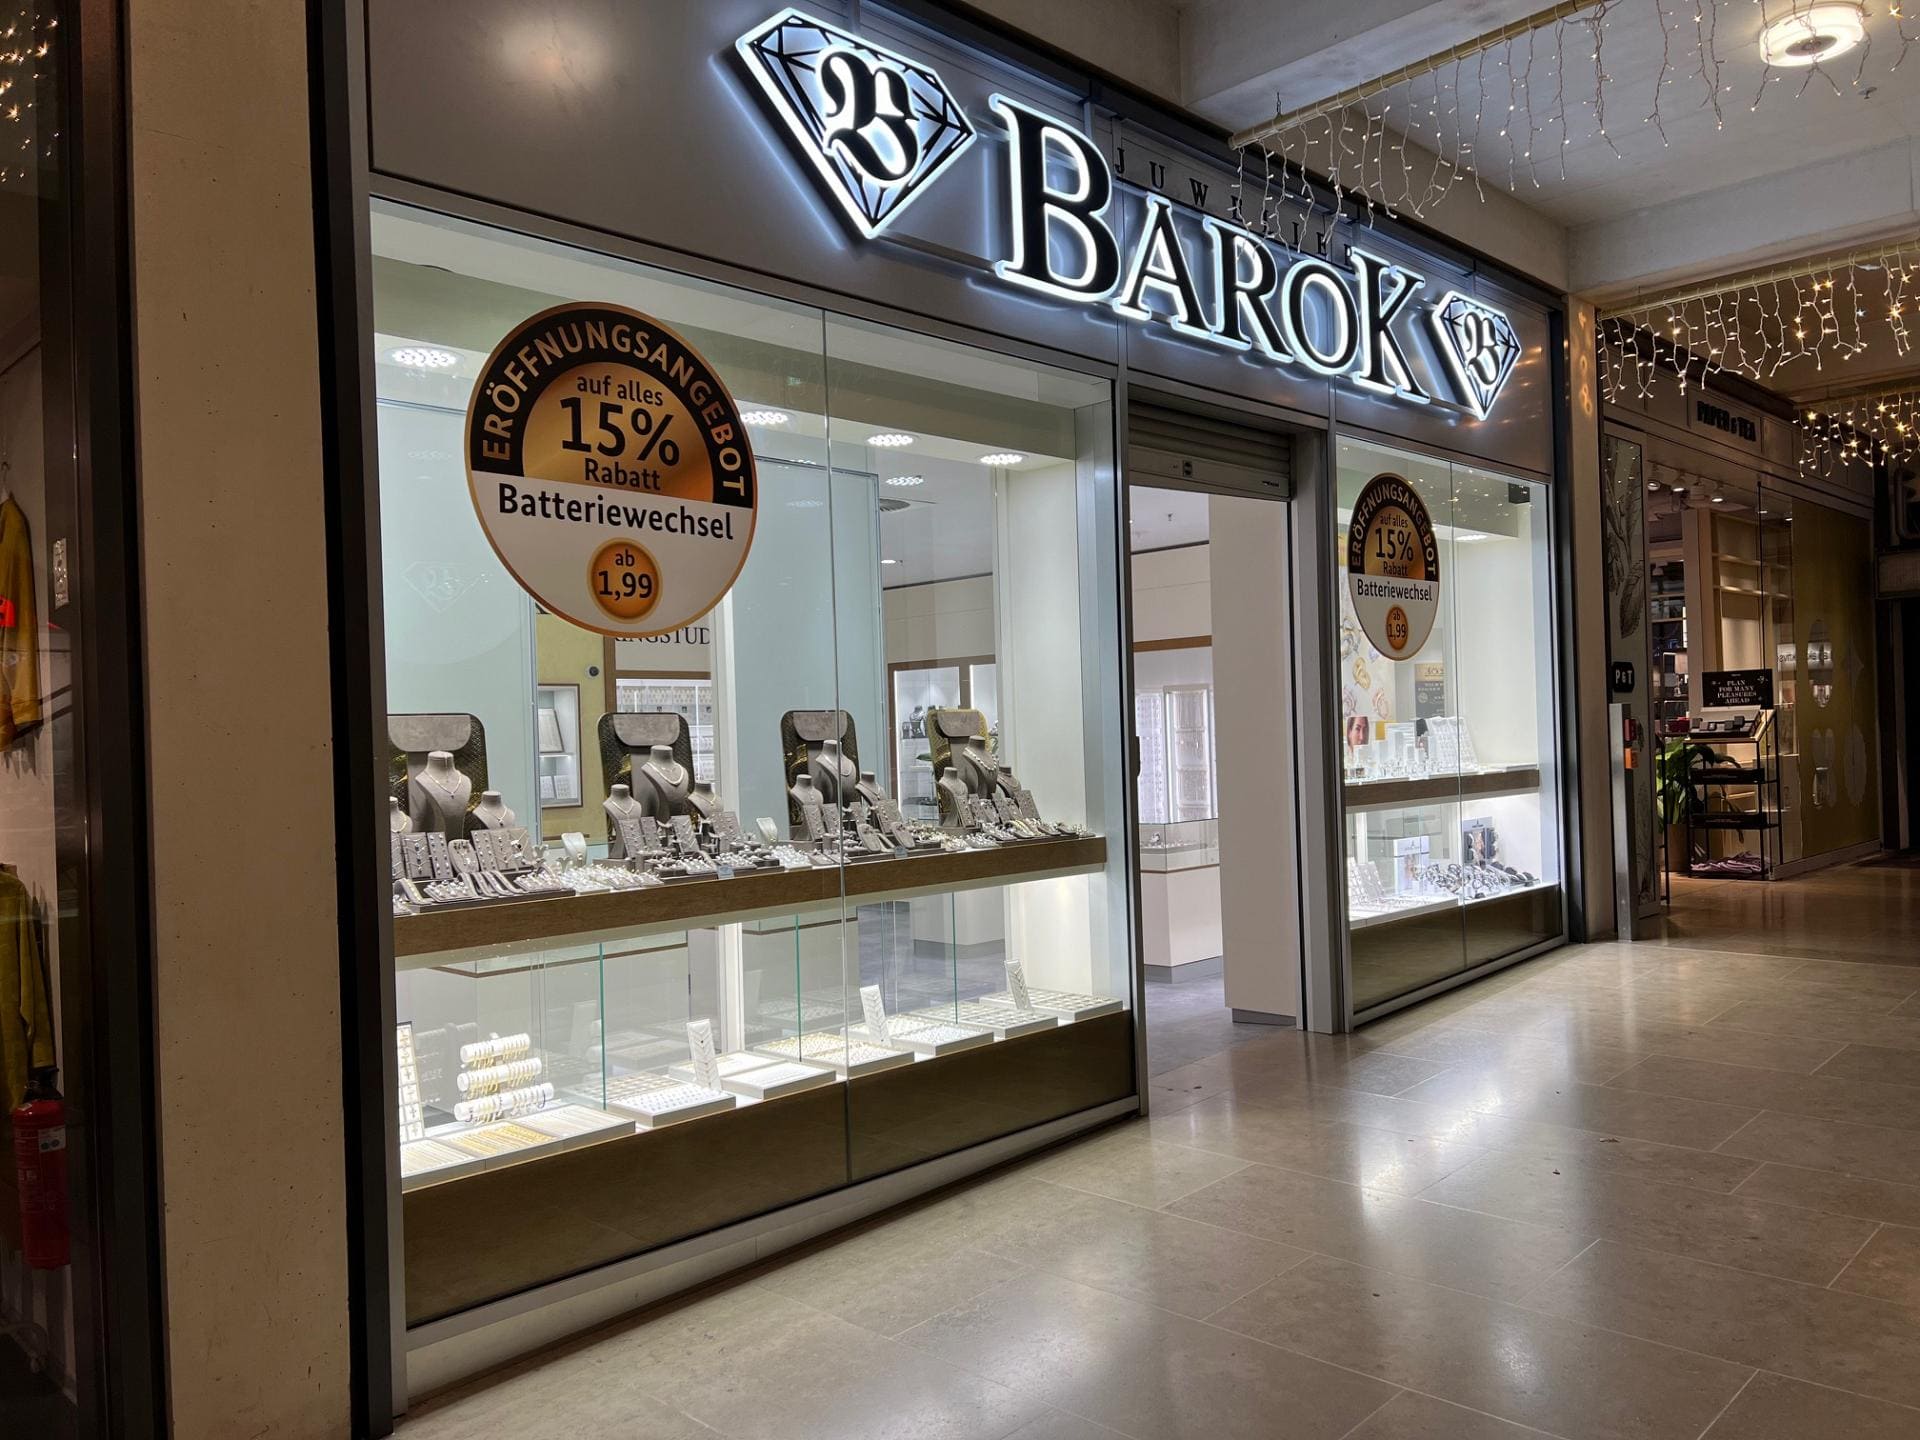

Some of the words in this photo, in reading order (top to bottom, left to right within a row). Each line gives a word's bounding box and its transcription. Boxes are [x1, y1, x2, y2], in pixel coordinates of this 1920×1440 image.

[990, 93, 1430, 404] BAROK
[577, 375, 612, 396] auf
[617, 380, 664, 406] alles
[482, 320, 745, 497] ERÖFFNUNGSANGEBOT
[559, 396, 681, 468] 15%
[584, 458, 662, 491] Rabatt
[498, 483, 734, 540] Batteriewechsel
[1379, 514, 1393, 526] auf
[1393, 516, 1409, 529] alles
[1352, 484, 1436, 576] ERÖFFNUNGSANGEBOT
[1375, 527, 1415, 562] 15%
[614, 549, 636, 568] ab
[1383, 561, 1409, 577] Rabatt
[598, 570, 653, 601] 1,99
[1357, 578, 1433, 602] Batteriewechsel
[1388, 623, 1407, 639] 1,99
[1392, 611, 1401, 621] ab
